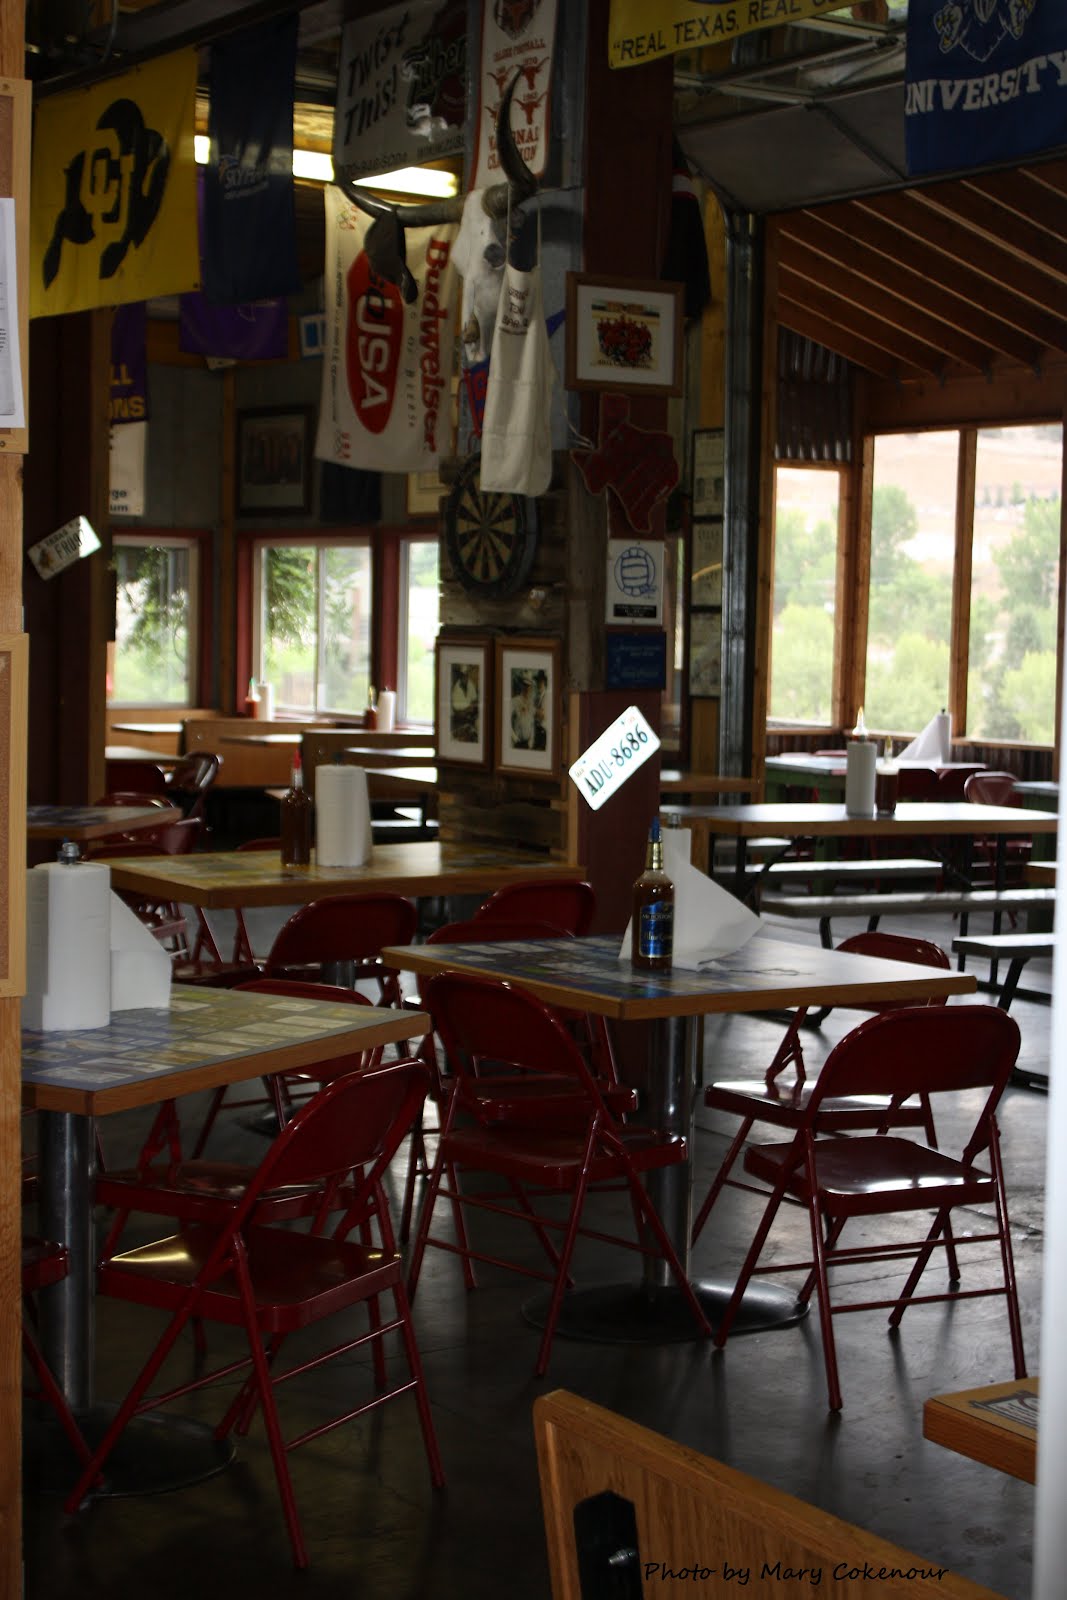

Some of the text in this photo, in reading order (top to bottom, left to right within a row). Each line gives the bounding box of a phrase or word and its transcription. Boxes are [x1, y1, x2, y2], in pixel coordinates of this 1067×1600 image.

[349, 12, 409, 97] Twist
[344, 64, 397, 146] This!
[356, 293, 392, 409] USA
[420, 237, 450, 453] Budweiser
[584, 723, 648, 796] ADU-8686
